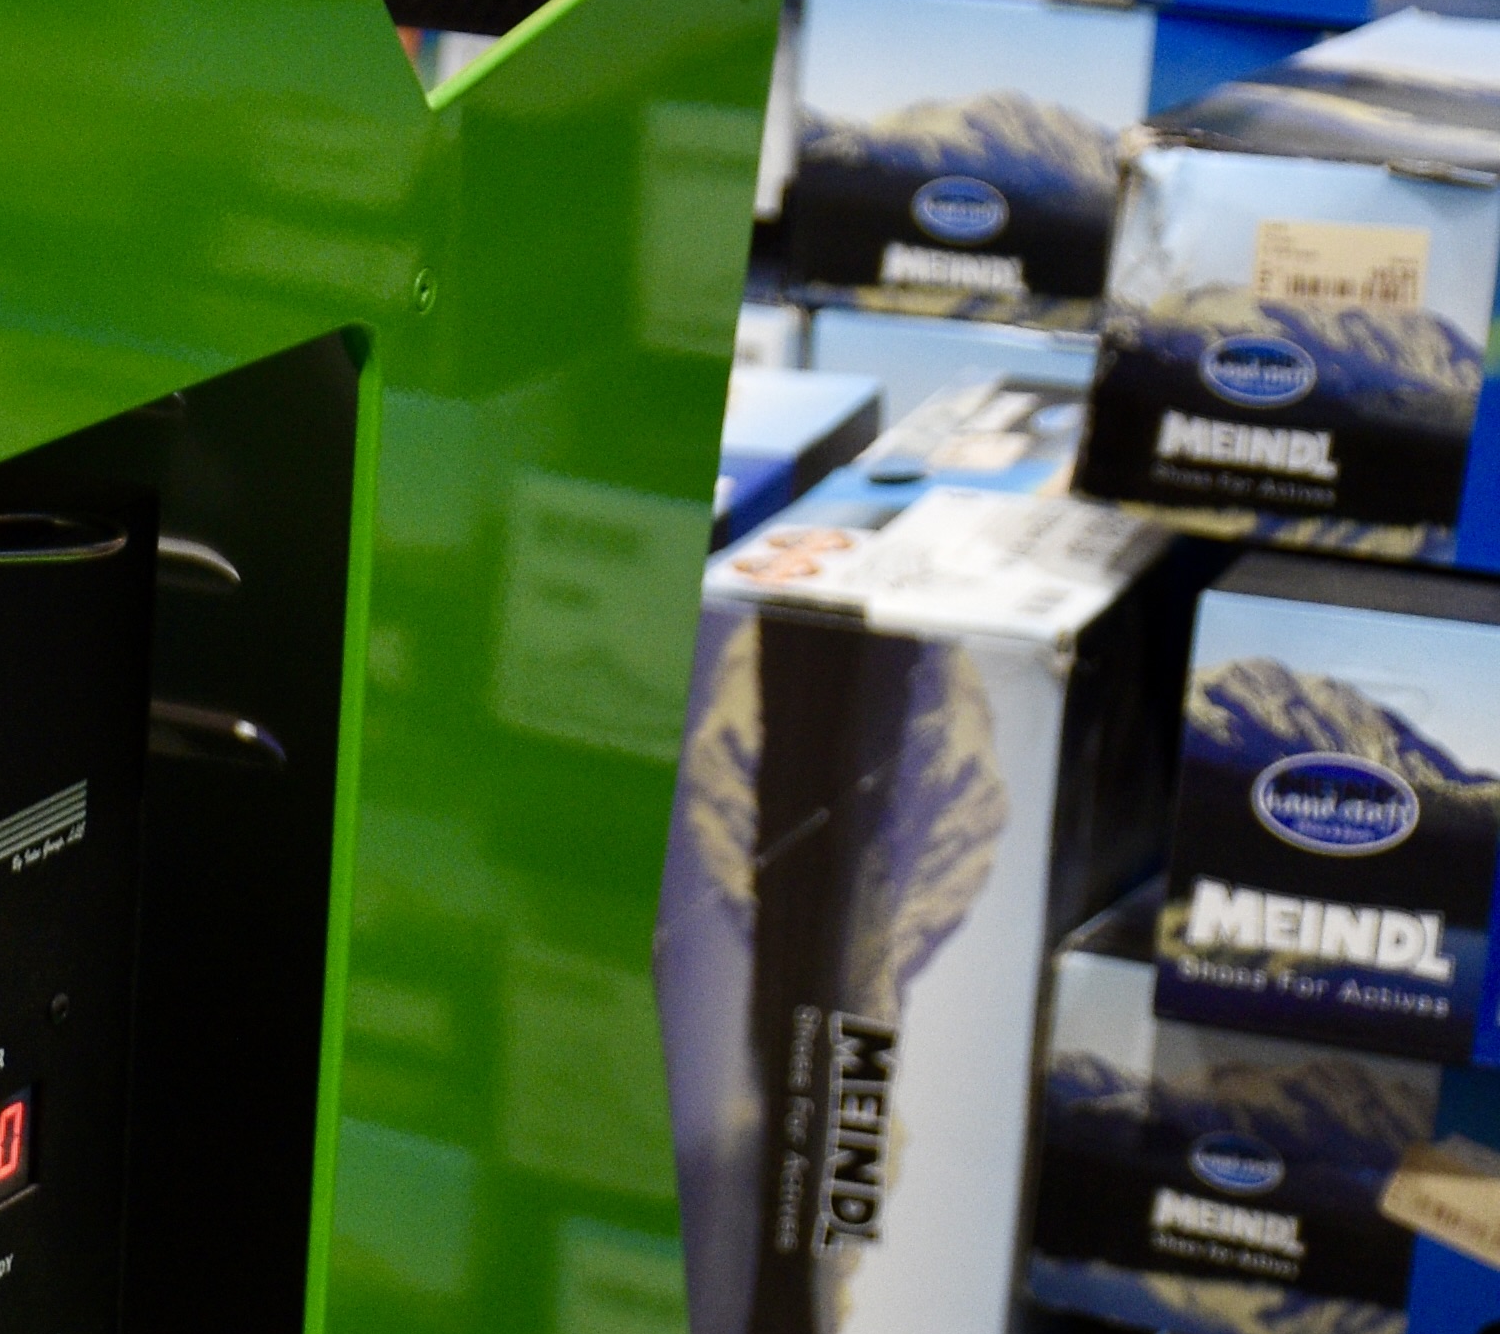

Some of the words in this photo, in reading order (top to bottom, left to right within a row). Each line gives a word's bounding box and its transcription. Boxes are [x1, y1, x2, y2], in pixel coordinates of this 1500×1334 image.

[1155, 409, 1340, 482] MEINDL
[1186, 874, 1455, 986] MEINDL
[1177, 953, 1268, 994] Shoes
[1275, 967, 1328, 1001] For
[1336, 976, 1450, 1018] Actives
[811, 1009, 902, 1260] MEINDL
[1153, 1185, 1305, 1261] MEINDL
